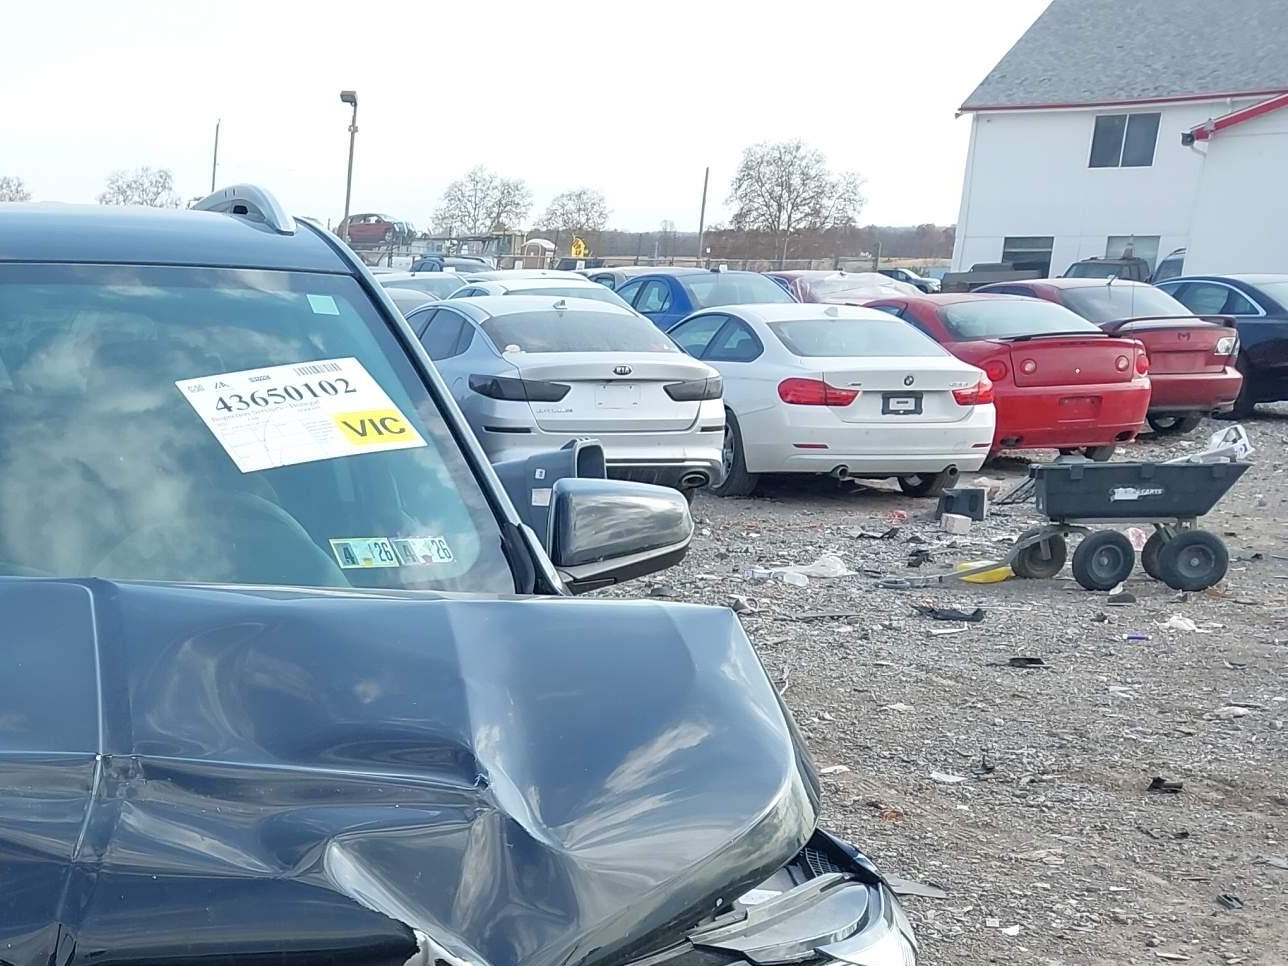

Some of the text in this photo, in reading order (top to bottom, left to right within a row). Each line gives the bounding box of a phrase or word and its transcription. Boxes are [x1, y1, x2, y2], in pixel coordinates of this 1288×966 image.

[215, 377, 357, 413] 43650102
[340, 416, 406, 437] VIC
[374, 542, 393, 562] 26
[431, 540, 452, 560] 26
